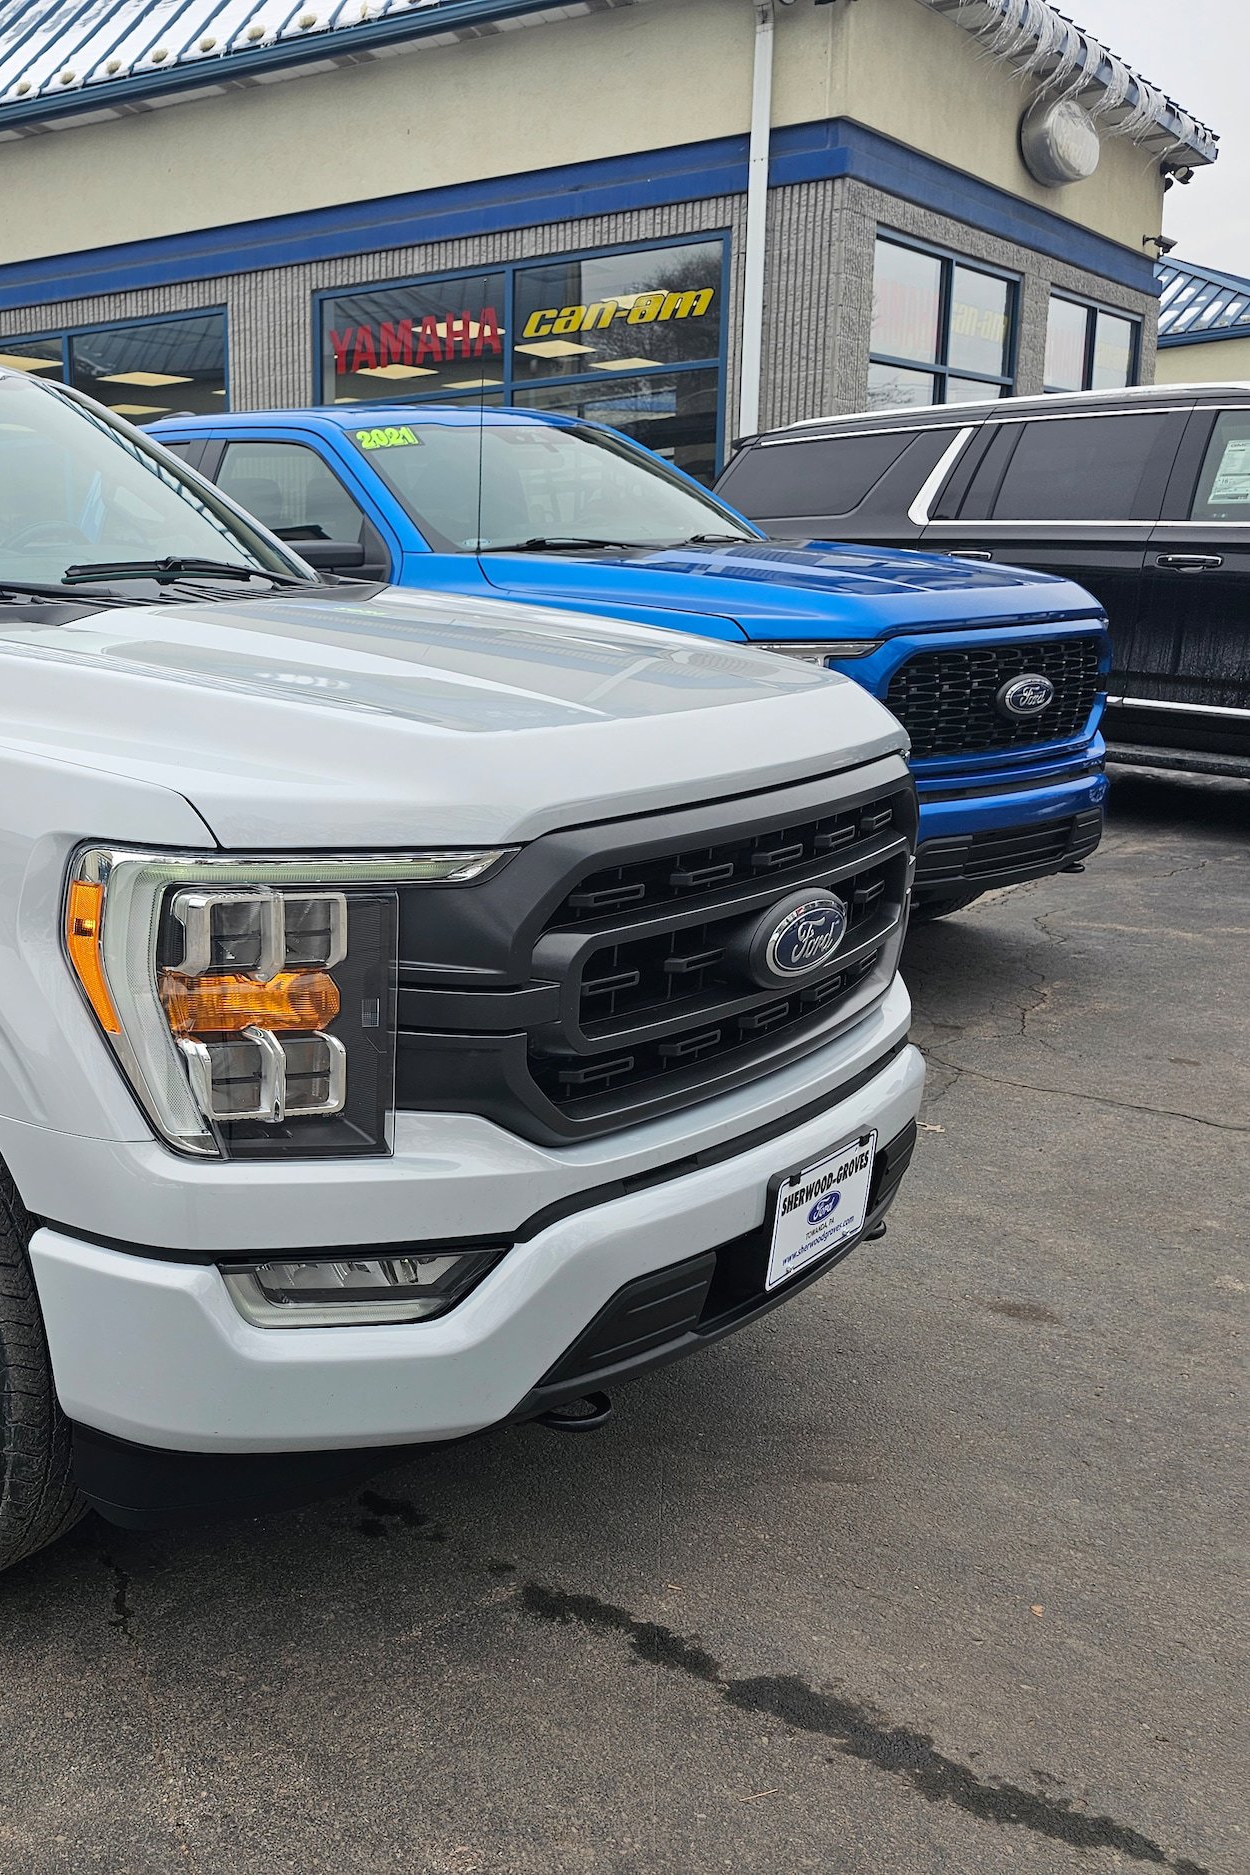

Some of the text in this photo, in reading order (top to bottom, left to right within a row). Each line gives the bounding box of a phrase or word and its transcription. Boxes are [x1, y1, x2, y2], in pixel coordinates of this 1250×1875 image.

[329, 306, 502, 375] YAMAHA
[355, 426, 419, 450] 2021
[1019, 685, 1047, 707] Ford
[790, 916, 836, 964] Ford
[781, 1149, 870, 1217] SHERWOOD-GROVES
[812, 1196, 836, 1221] Ford
